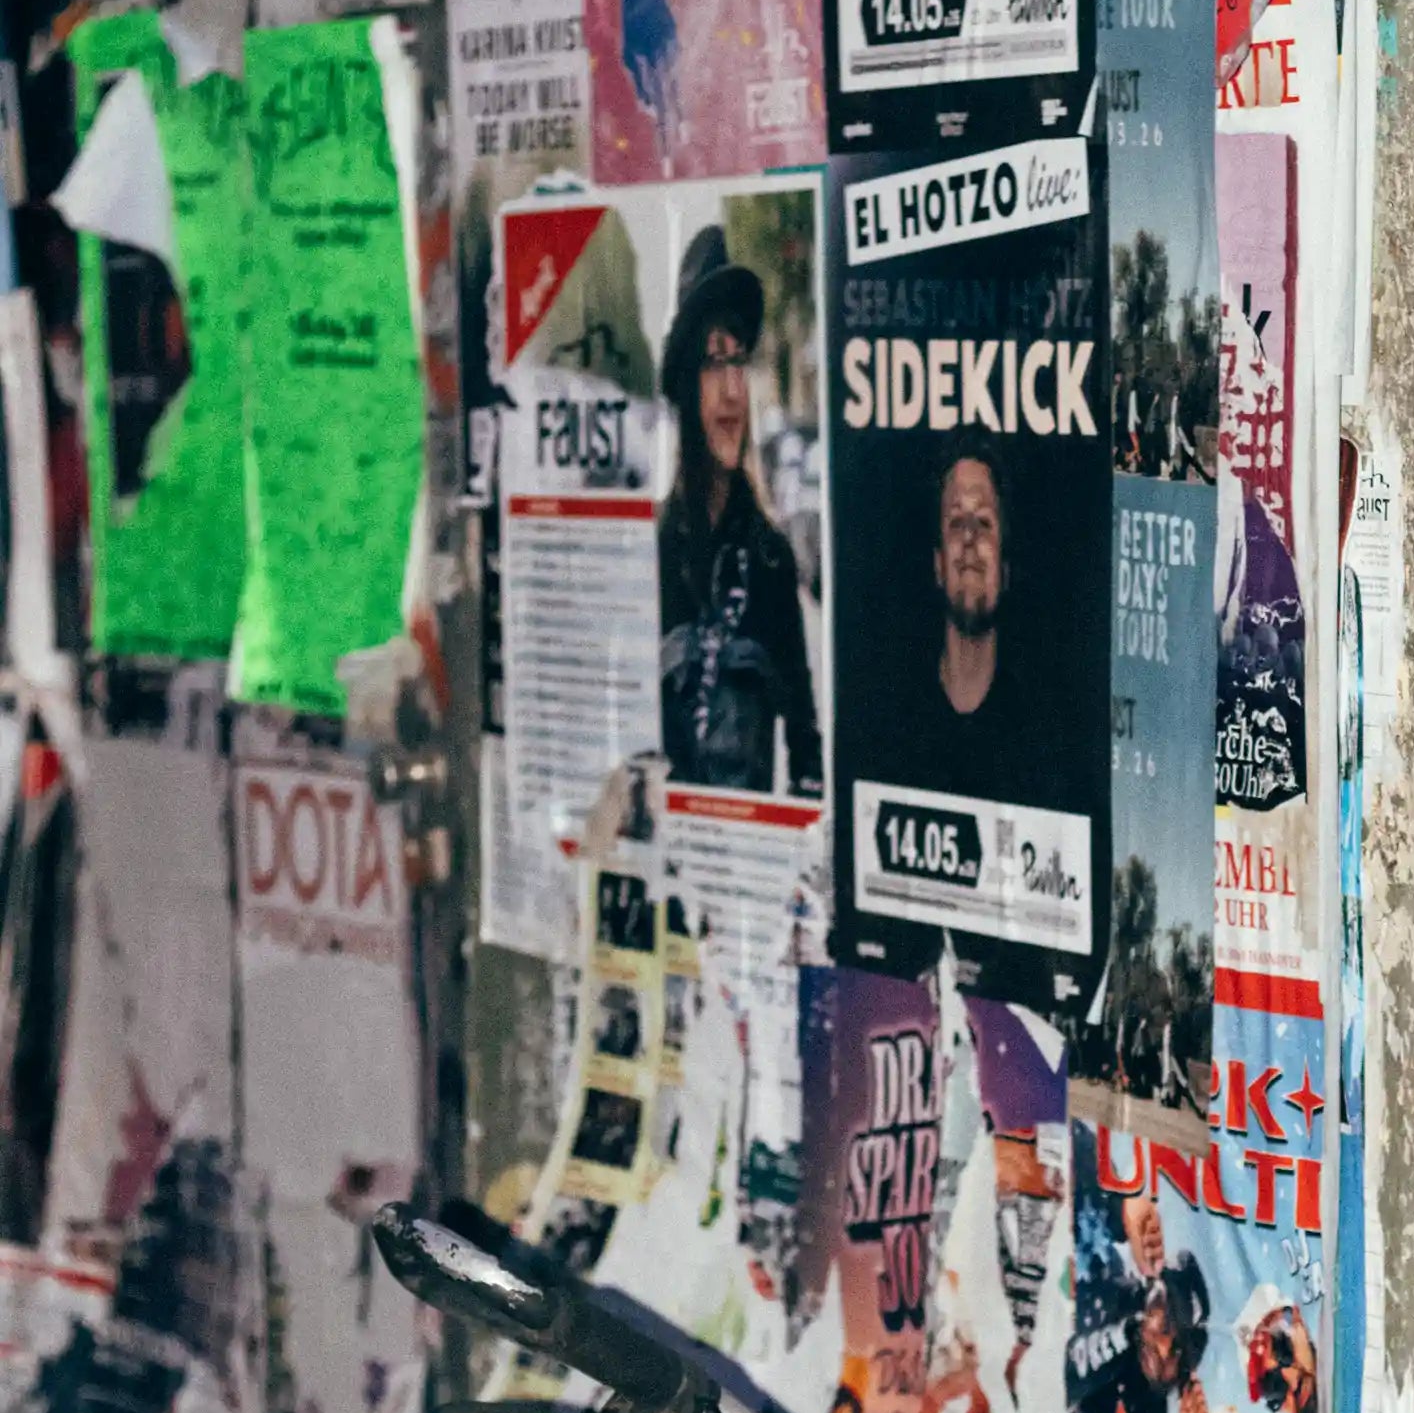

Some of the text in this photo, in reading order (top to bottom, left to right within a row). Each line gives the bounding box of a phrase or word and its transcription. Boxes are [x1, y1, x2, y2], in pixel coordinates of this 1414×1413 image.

[856, 156, 1081, 249] EL HOTZO live:
[843, 336, 1098, 436] SIDEKICK
[1120, 508, 1196, 567] BETTER
[1117, 560, 1169, 613] DAYS
[1117, 609, 1169, 665] TOUR
[1225, 898, 1269, 931] UHR
